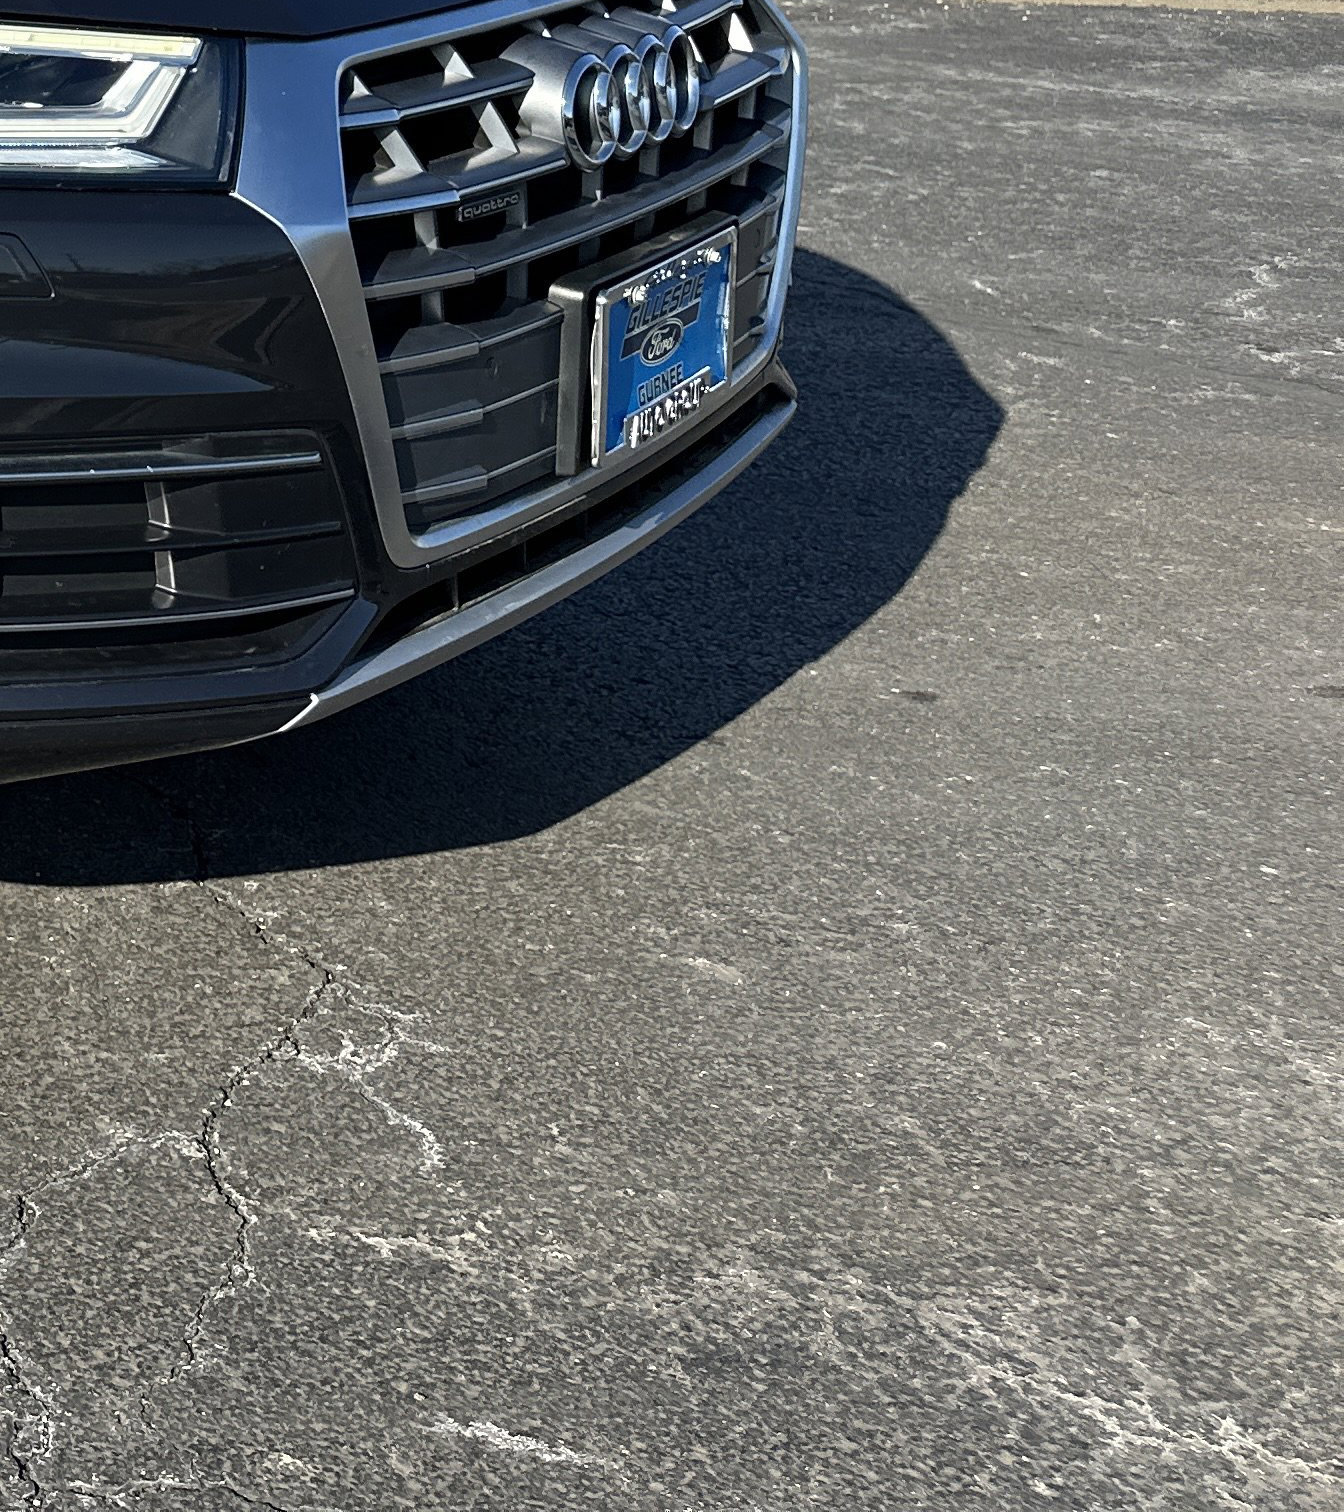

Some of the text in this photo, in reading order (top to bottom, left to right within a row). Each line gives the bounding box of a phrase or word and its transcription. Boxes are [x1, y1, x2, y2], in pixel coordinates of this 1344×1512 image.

[463, 192, 520, 219] quattro
[625, 270, 708, 336] GILLESPIE
[647, 326, 677, 360] Ford
[637, 361, 683, 407] GURNEE
